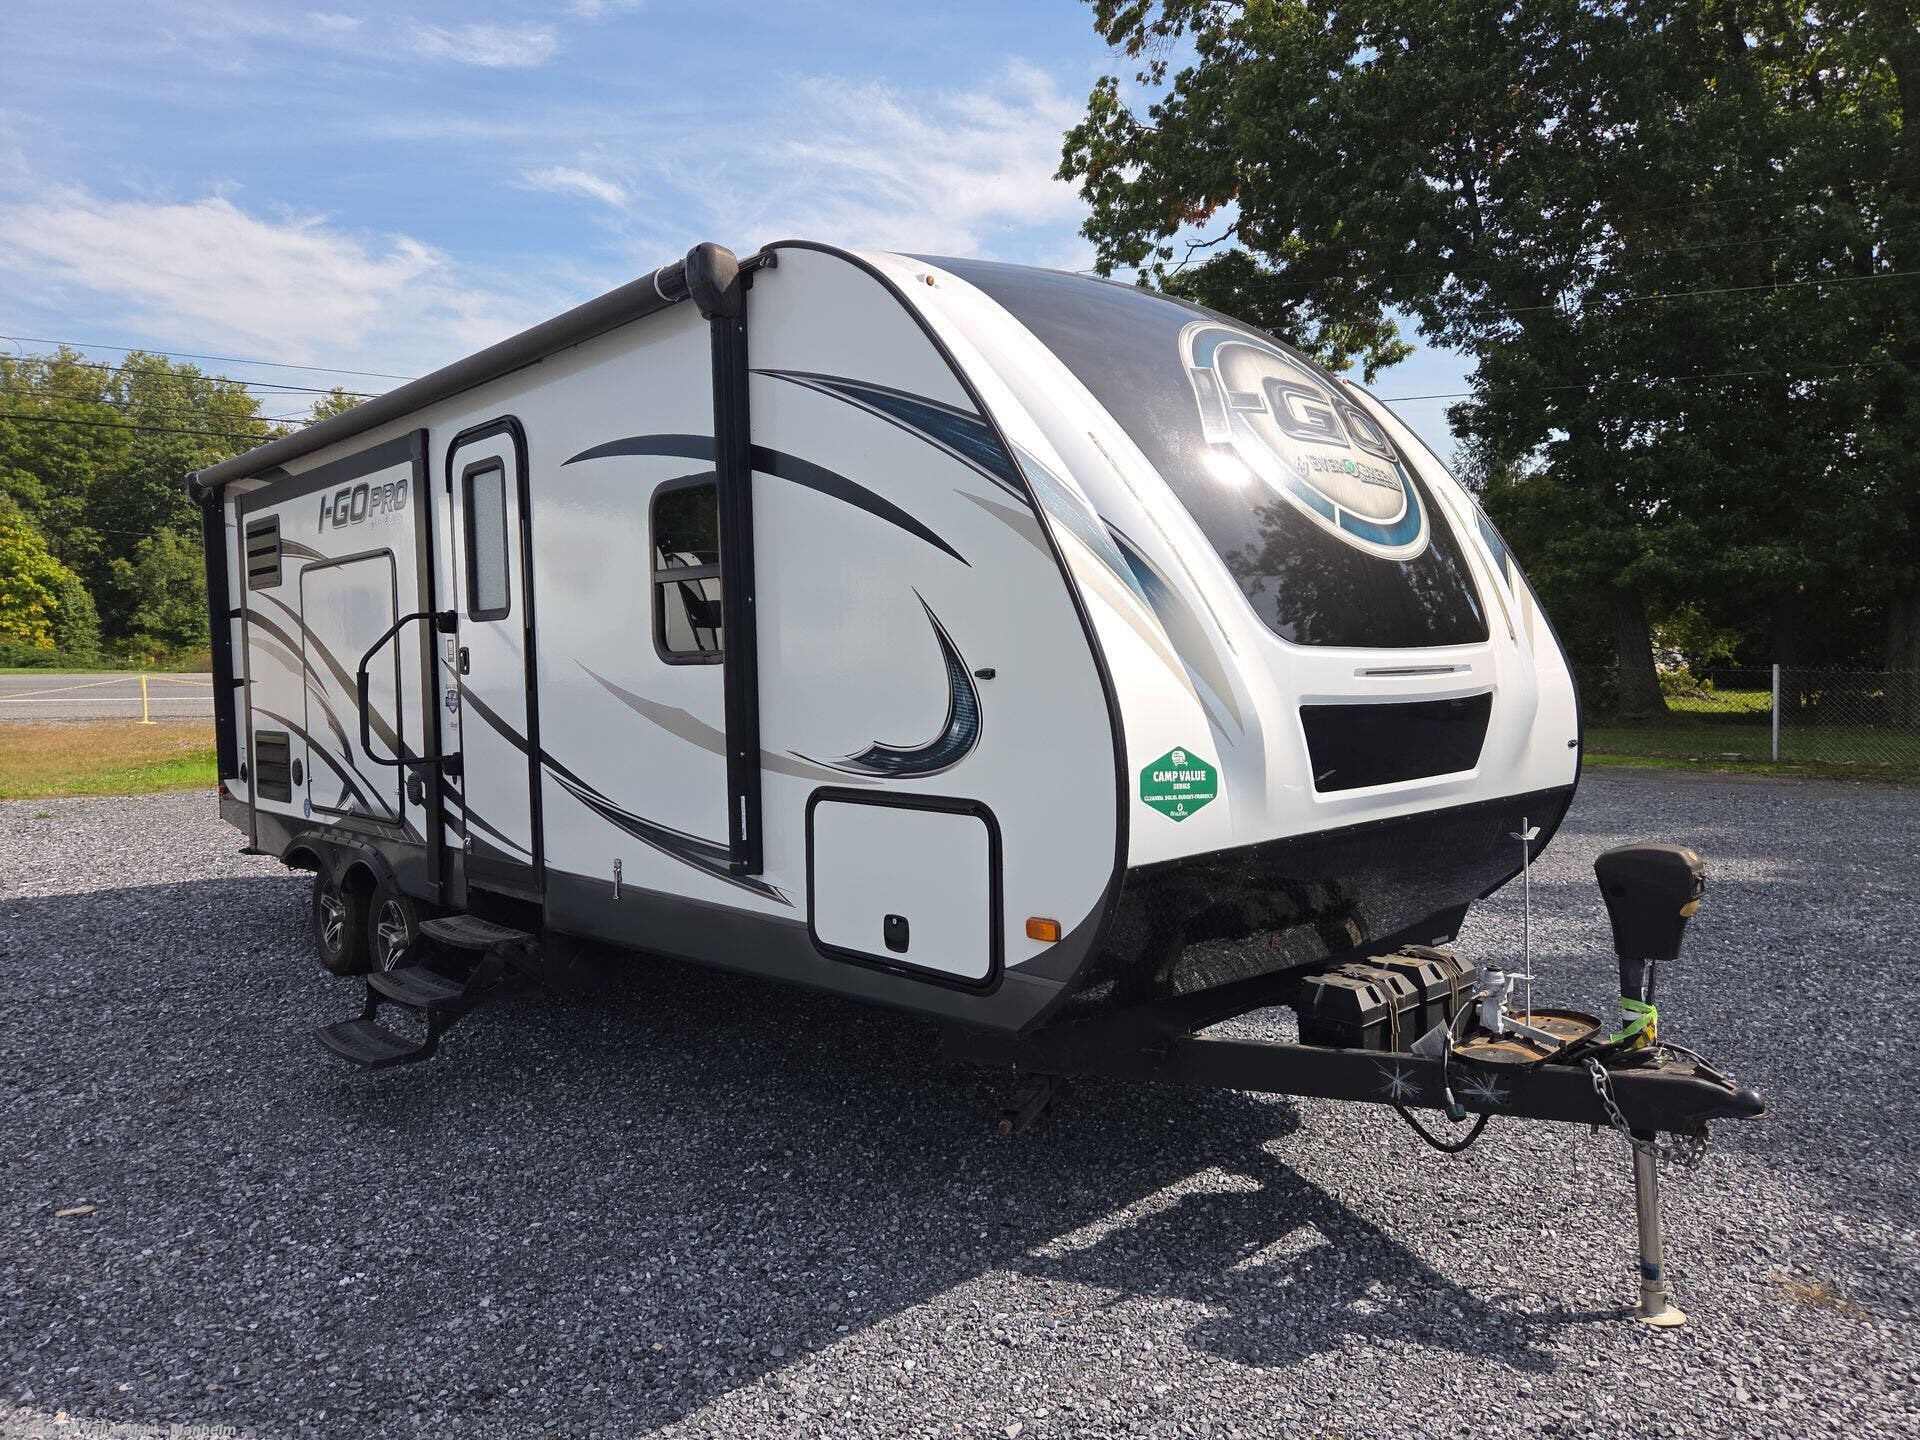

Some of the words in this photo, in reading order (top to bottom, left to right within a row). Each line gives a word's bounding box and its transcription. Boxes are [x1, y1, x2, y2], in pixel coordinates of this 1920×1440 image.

[1190, 366, 1398, 463] I-GO
[318, 482, 370, 535] I-GO
[368, 478, 408, 518] PRO
[1153, 771, 1178, 782] CAMP
[1179, 771, 1206, 781] VALUE
